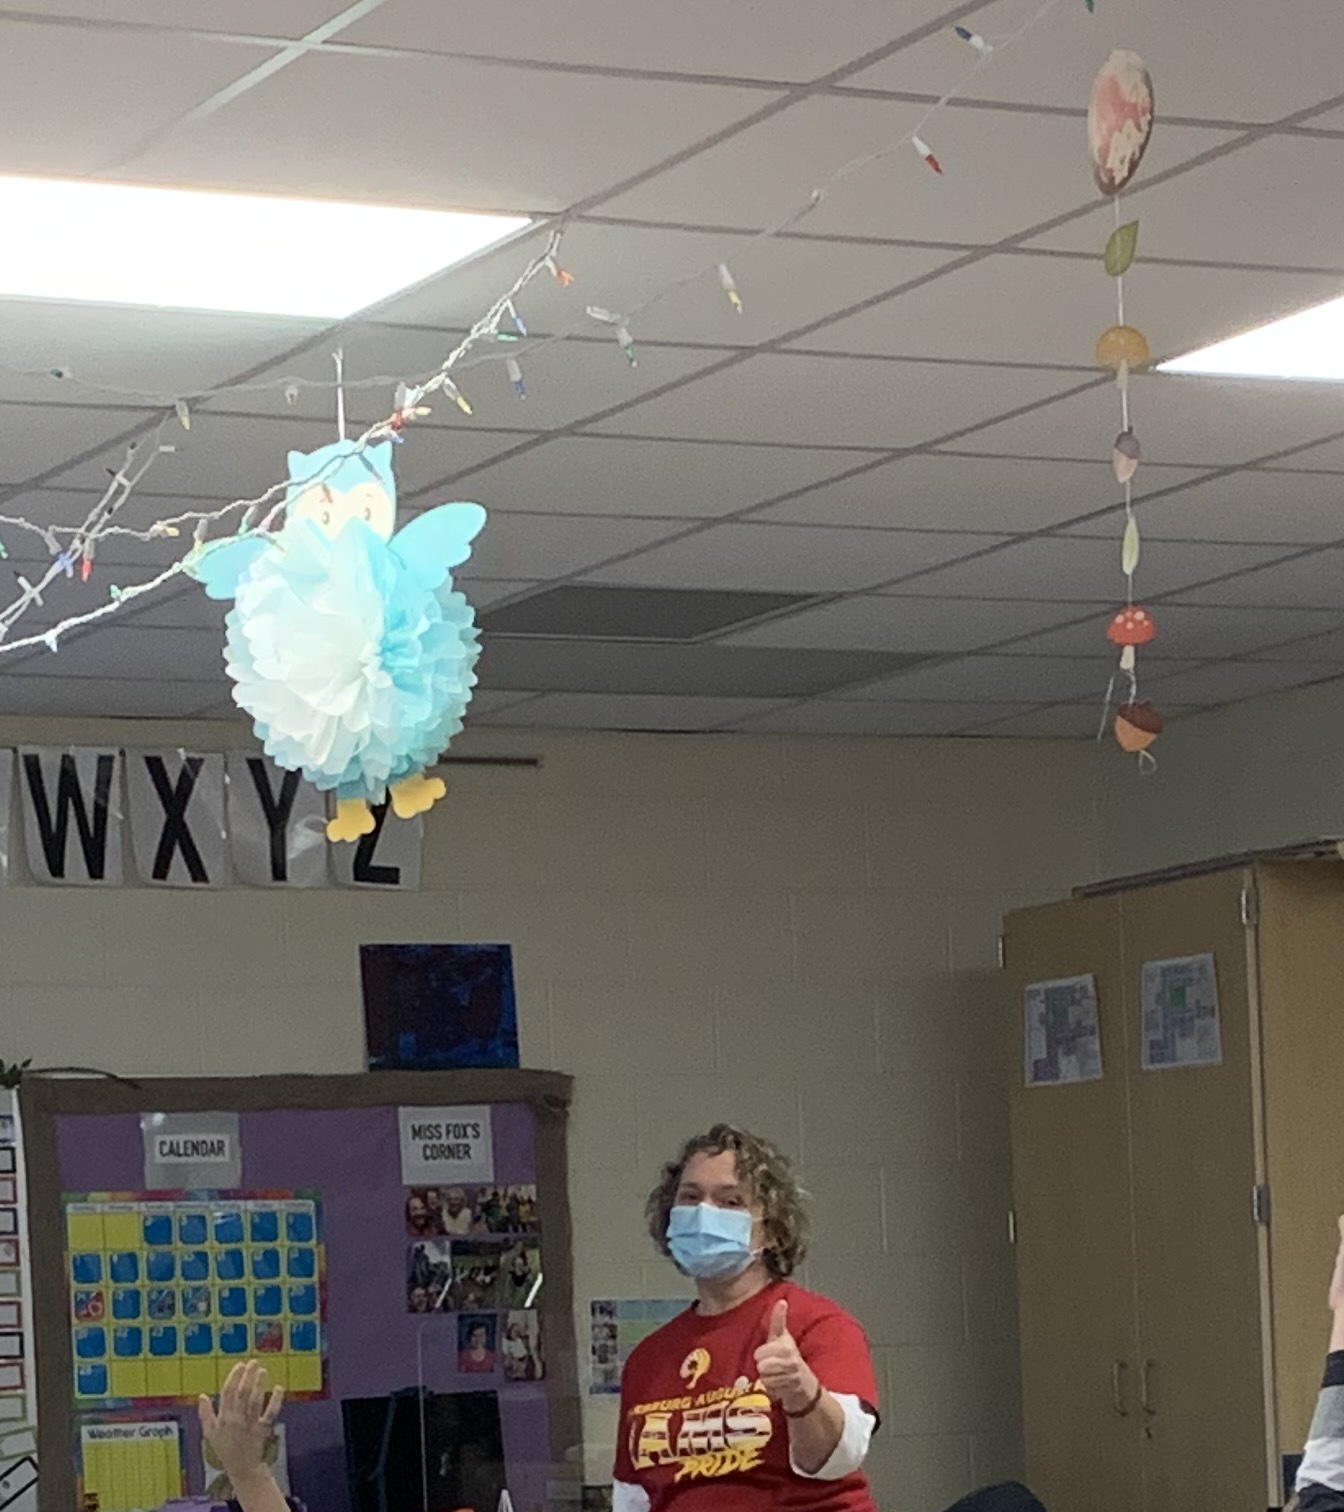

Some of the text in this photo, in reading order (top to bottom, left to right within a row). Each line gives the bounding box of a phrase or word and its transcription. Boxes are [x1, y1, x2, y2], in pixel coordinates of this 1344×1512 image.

[22, 752, 114, 881] W
[142, 754, 212, 882] X
[243, 756, 302, 882] Y
[411, 1122, 482, 1142] MISS FOX'S
[159, 1139, 226, 1158] CALENDAR
[422, 1143, 473, 1162] CORNER
[87, 1424, 173, 1440] Weather Graph
[674, 1448, 766, 1484] PRIDE
